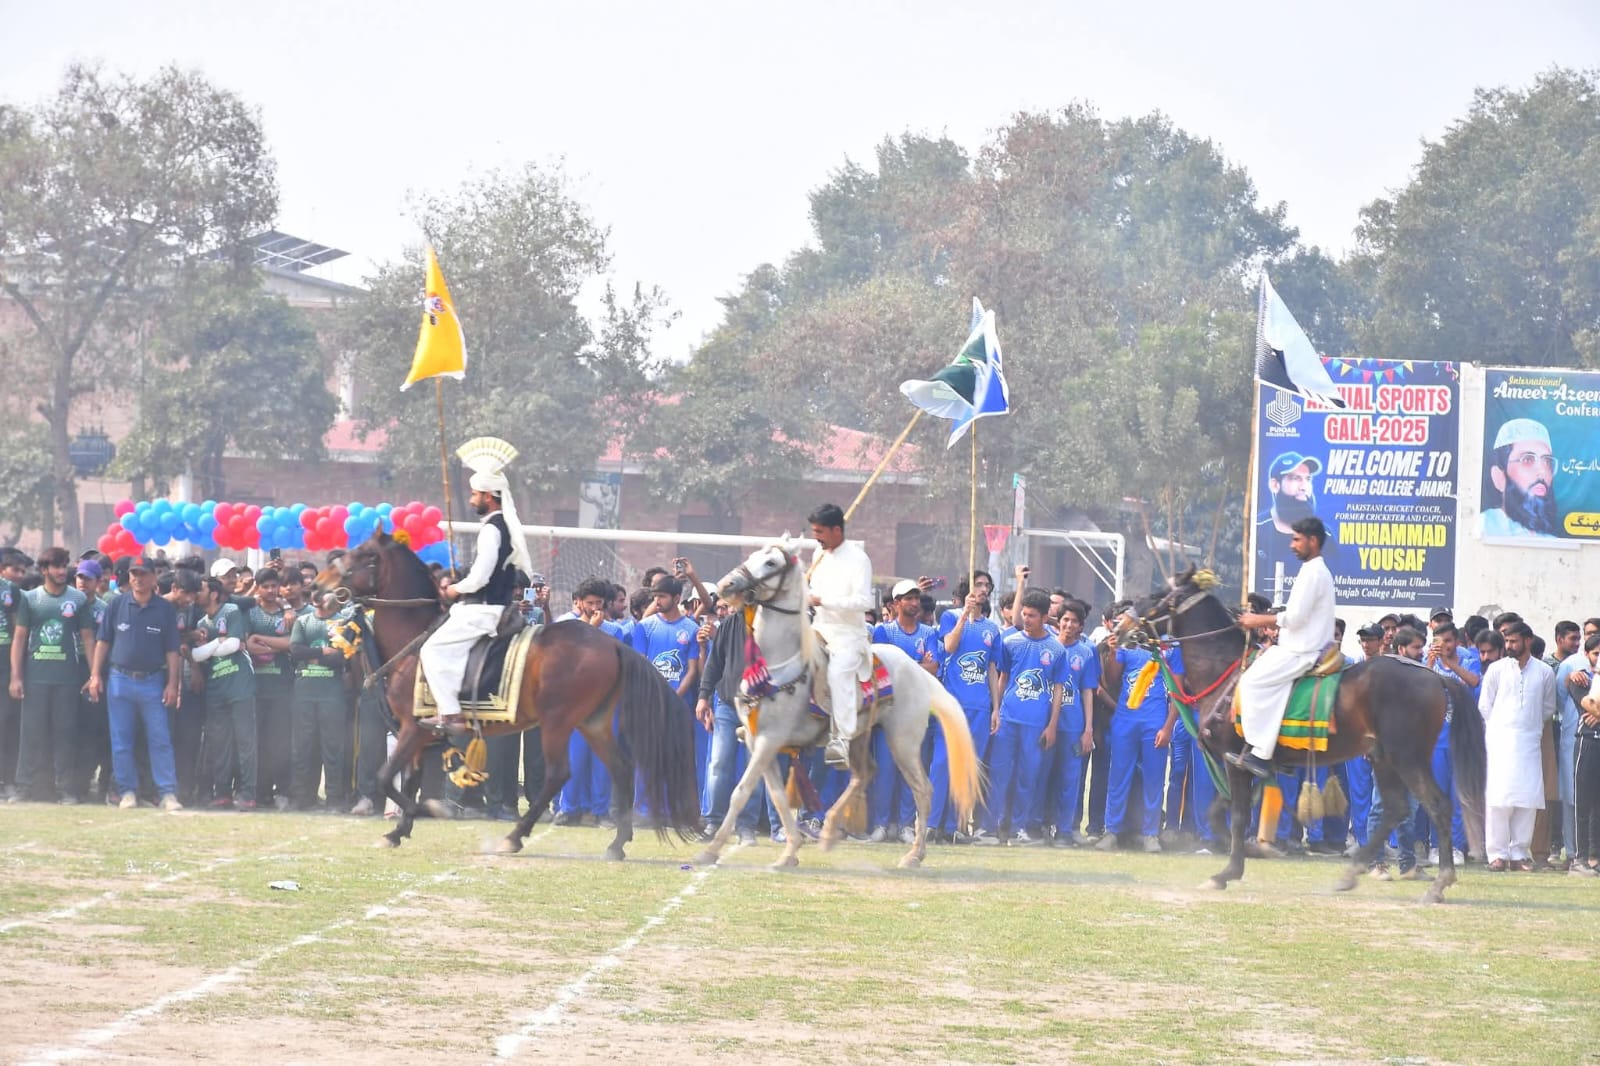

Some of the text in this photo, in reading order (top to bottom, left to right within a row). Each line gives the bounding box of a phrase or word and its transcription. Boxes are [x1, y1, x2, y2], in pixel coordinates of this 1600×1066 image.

[1508, 376, 1562, 387] International
[1379, 387, 1449, 412] SPORTS
[1327, 417, 1427, 442] GALA-2025
[1327, 449, 1452, 477] WELCOME TO
[1324, 479, 1452, 497] PUNJAB COLLEGE JHANG
[1335, 512, 1454, 523] FORMER CRICKETER AND CAPTAIN
[1346, 503, 1441, 514] PAKISTANI CRICKET COACH,
[1339, 522, 1447, 547] MUHAMMAD
[1358, 547, 1426, 572] YOUSAF
[1334, 575, 1431, 588] Muhammad Adnan Ullah
[1333, 586, 1416, 600] Punjab College Jhang
